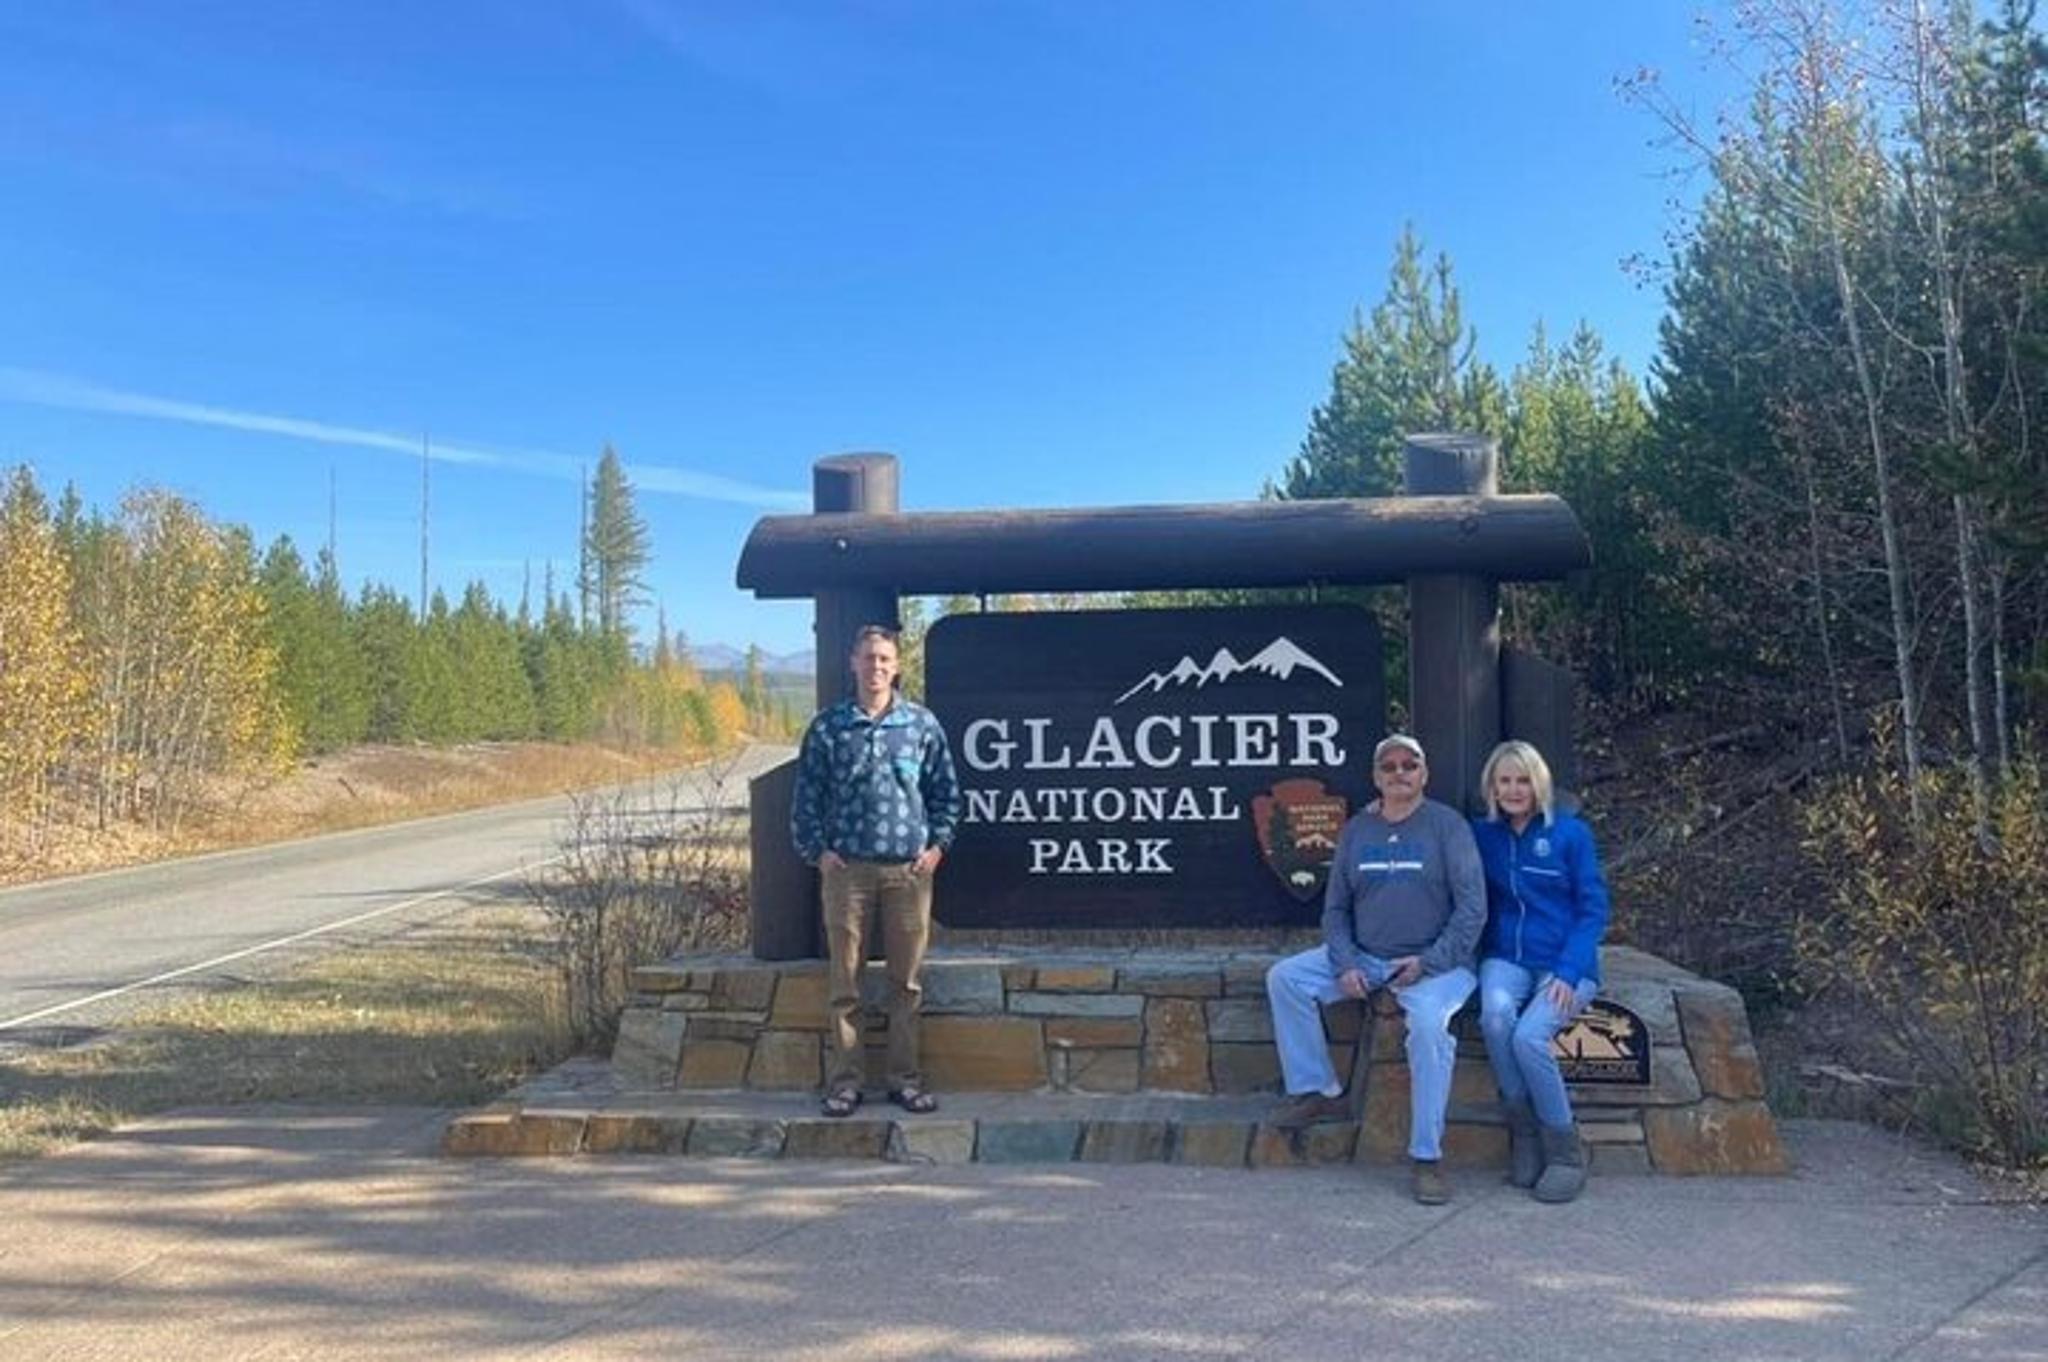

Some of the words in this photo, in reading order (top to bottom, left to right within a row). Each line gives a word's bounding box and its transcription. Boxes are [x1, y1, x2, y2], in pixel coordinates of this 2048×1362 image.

[963, 713, 1346, 771] GLACIER
[964, 786, 1240, 823] NATIONAL
[1029, 838, 1173, 873] PARK
